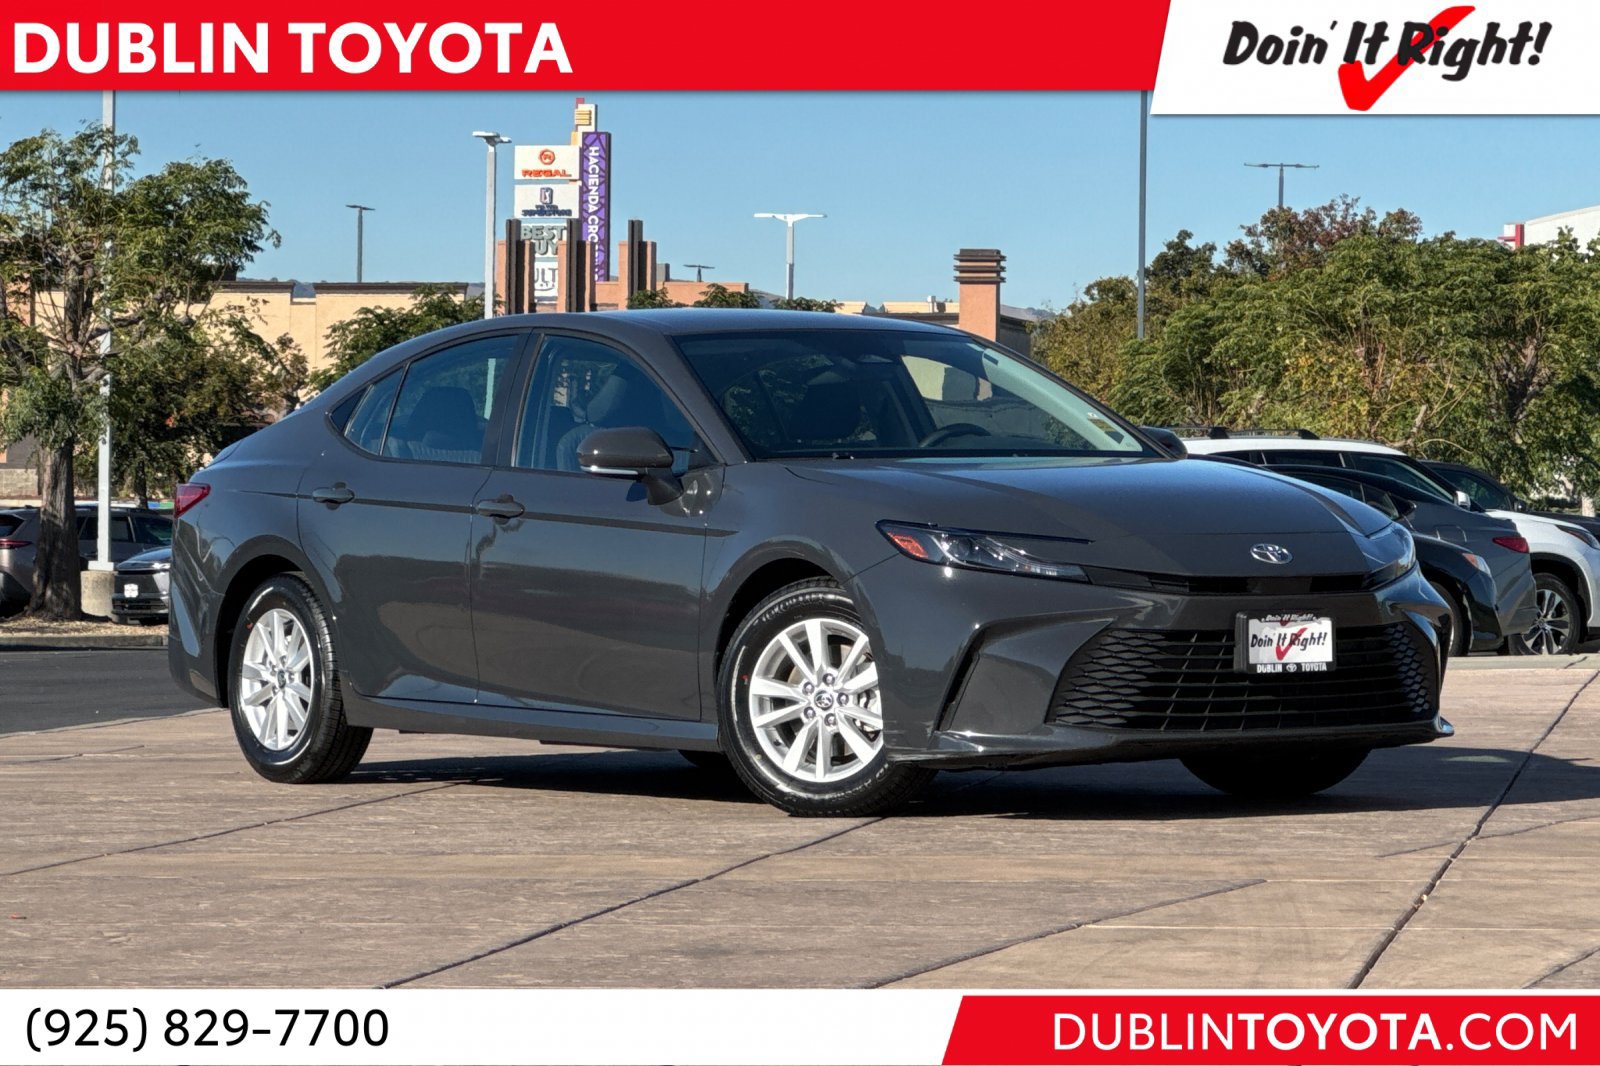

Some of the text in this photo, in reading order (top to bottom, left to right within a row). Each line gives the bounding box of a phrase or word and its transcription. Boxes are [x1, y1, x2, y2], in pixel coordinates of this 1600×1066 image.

[521, 169, 572, 178] REGAL
[588, 146, 600, 213] HACIENDA
[520, 225, 566, 241] BEST
[534, 239, 559, 255] UY
[1277, 633, 1288, 647] It
[1290, 632, 1328, 651] Right!
[1256, 663, 1327, 673] DUBLIN TOYOTA
